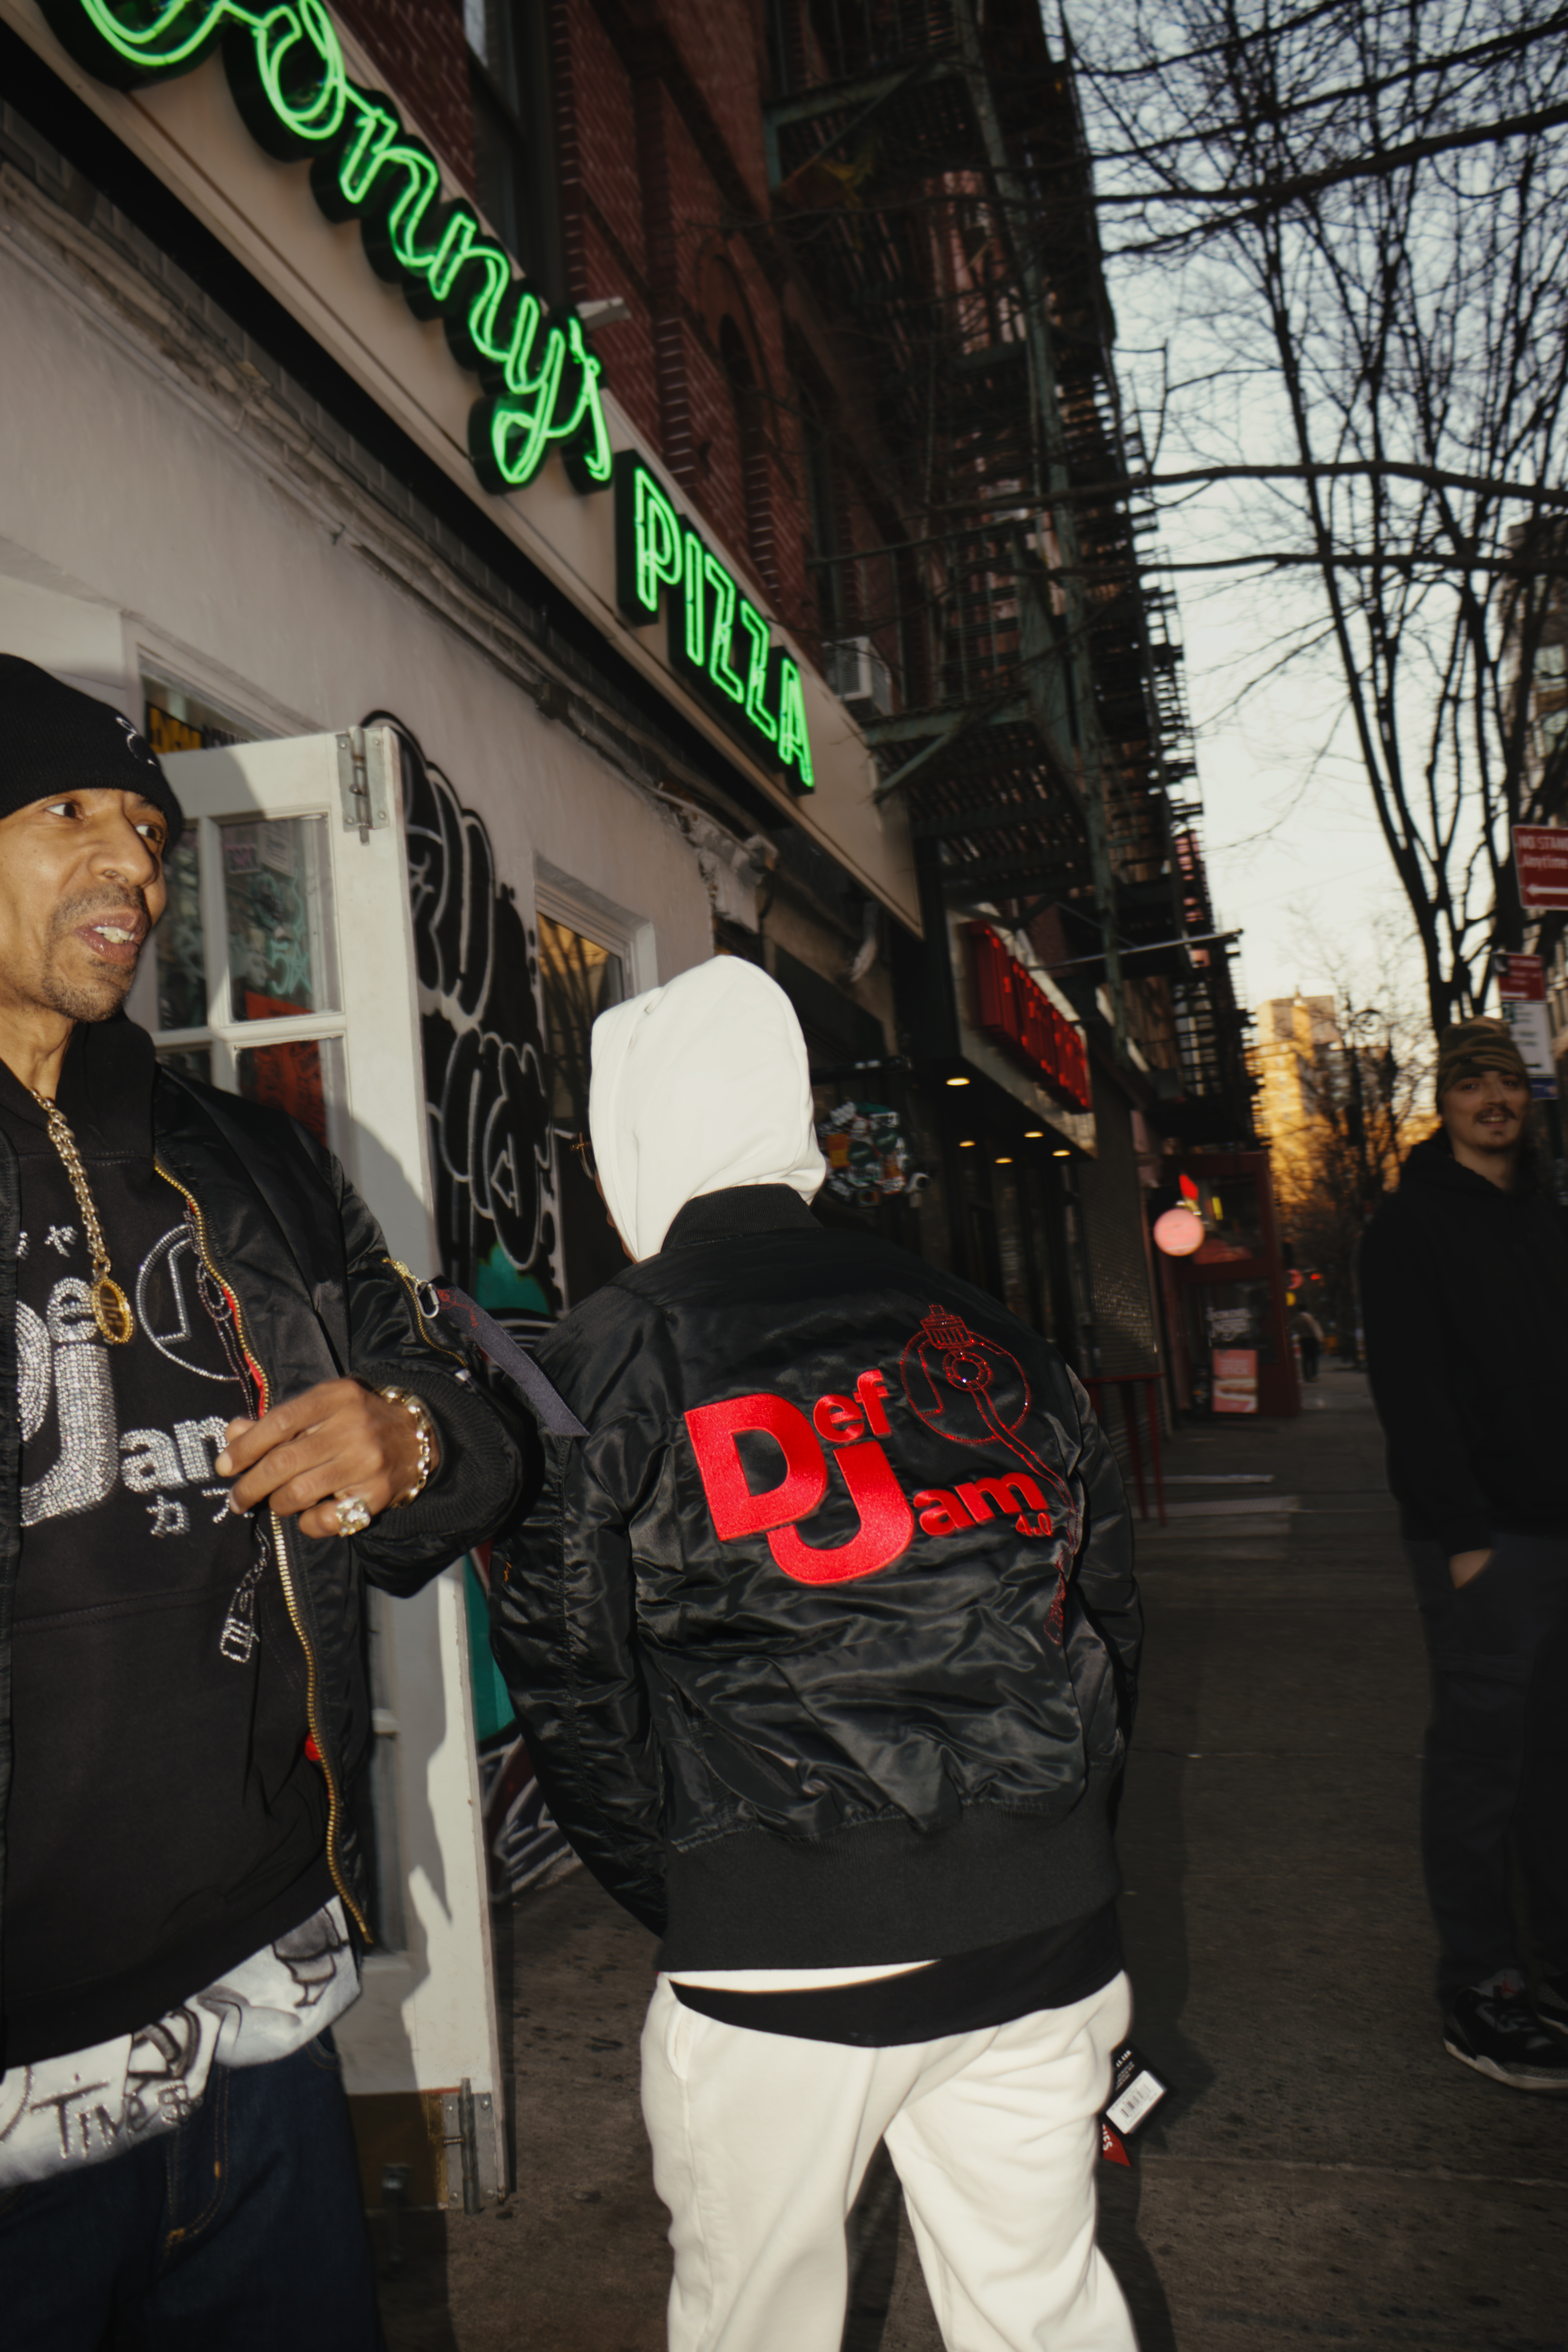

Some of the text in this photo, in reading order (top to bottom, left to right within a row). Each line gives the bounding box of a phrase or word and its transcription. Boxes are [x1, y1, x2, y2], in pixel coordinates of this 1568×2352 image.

[634, 467, 814, 787] PIZZA
[1518, 835, 1535, 850] NO
[684, 1369, 891, 1541] Def
[766, 1439, 1047, 1585] Jam
